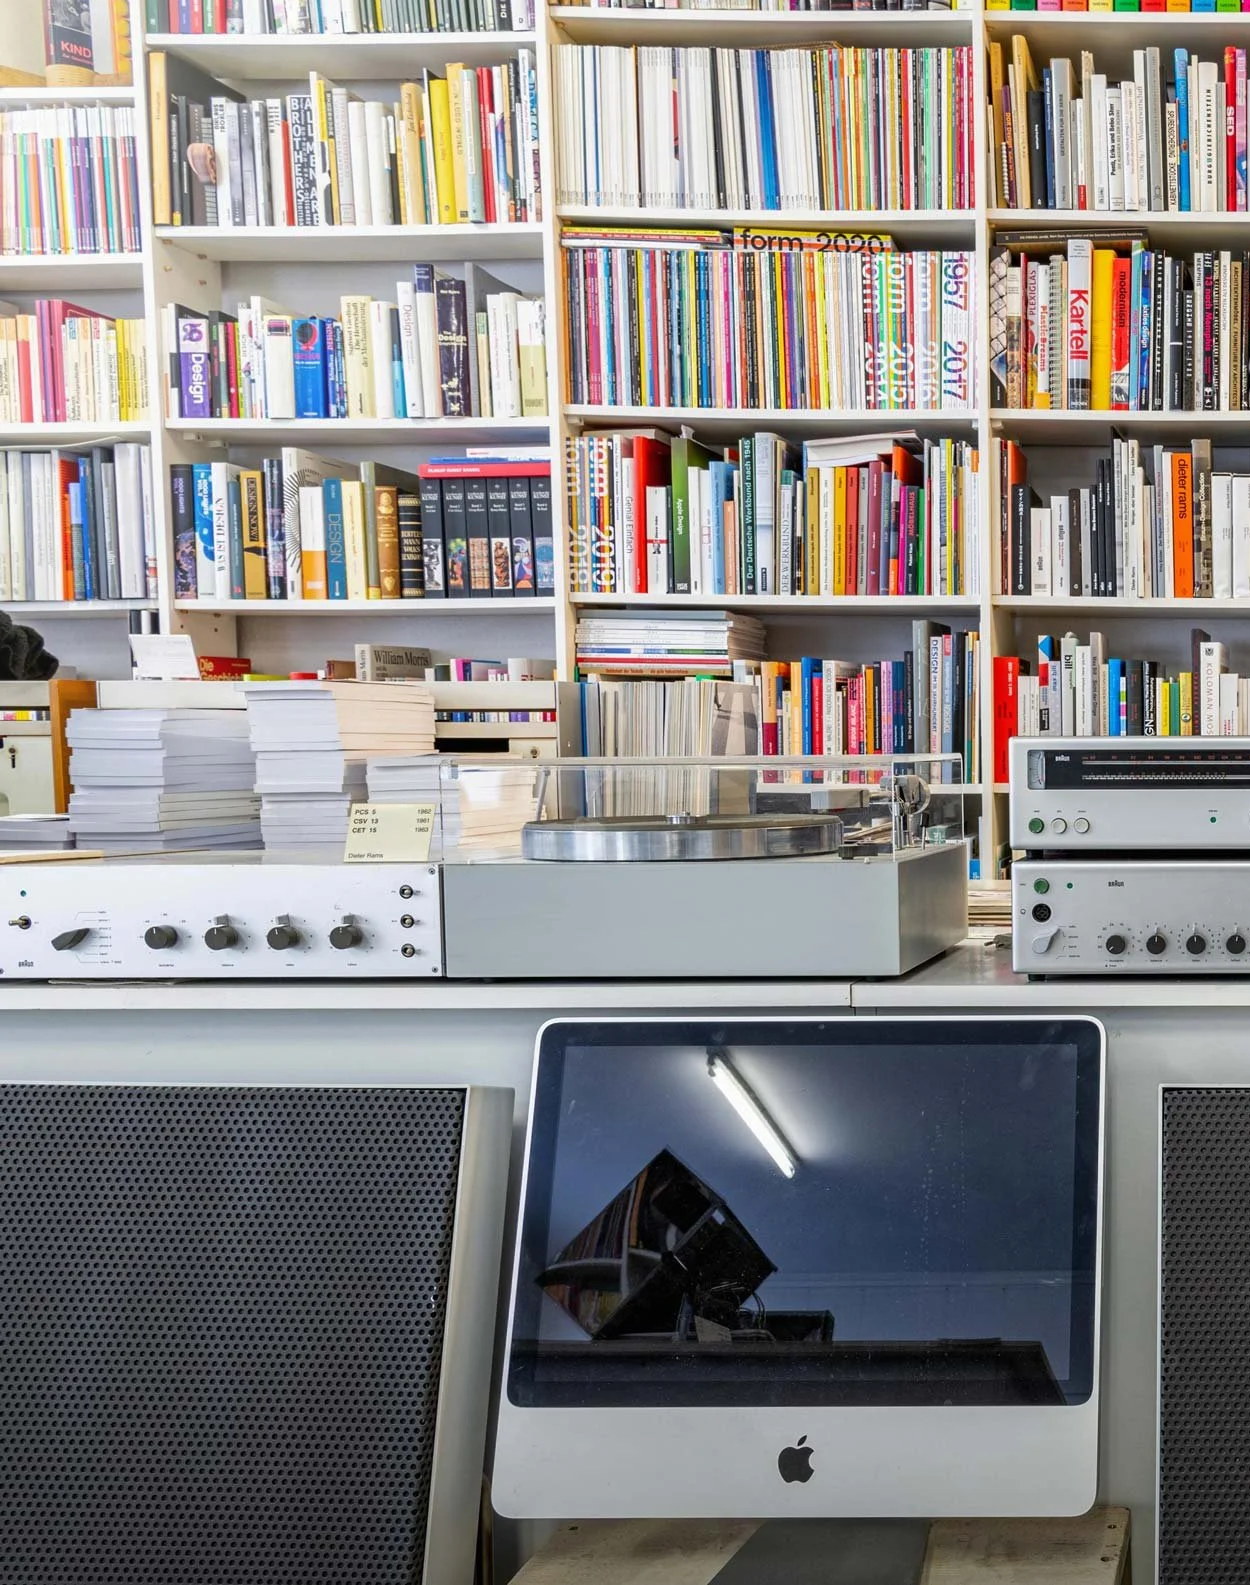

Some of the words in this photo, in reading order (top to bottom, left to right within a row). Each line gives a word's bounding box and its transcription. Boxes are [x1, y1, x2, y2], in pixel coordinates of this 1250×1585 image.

[60, 40, 92, 58] KIND
[1226, 106, 1235, 137] SED
[743, 229, 804, 252] form
[817, 232, 885, 255] 2020
[888, 252, 912, 313] form
[945, 253, 968, 312] 1957
[1029, 270, 1037, 316] PLEXIGLAS
[1205, 275, 1212, 287] 13
[1119, 271, 1127, 328] modernism
[401, 304, 412, 336] Design
[1070, 289, 1089, 360] Kartell
[1142, 325, 1150, 349] design
[189, 353, 204, 404] Design
[864, 341, 888, 402] 2014
[889, 341, 913, 402] 2015
[945, 341, 968, 402] 2017
[565, 437, 585, 497] form
[589, 437, 613, 497] form
[1177, 459, 1188, 489] dieter
[247, 478, 257, 512] DESIGN
[625, 496, 634, 522] Genial
[676, 498, 684, 515] Apple
[745, 482, 753, 524] Werkbund
[1177, 492, 1186, 520] rams
[248, 514, 259, 542] NOW!
[908, 491, 916, 537] MÖBELHAUS
[328, 513, 341, 564] DESIGN
[568, 524, 588, 586] 2018
[591, 525, 615, 586] 2019
[626, 523, 635, 554] Einfach
[745, 526, 753, 563] Deutsche
[781, 519, 790, 573] WERKBUND
[746, 564, 754, 579] Der
[781, 573, 790, 593] DER
[199, 658, 215, 672] Die
[373, 649, 405, 665] William
[404, 652, 430, 667] Morris
[931, 639, 939, 674] DESIGN
[1063, 654, 1073, 669] bill
[1055, 754, 1071, 762] BRAUN
[1108, 879, 1124, 888] BRAUN
